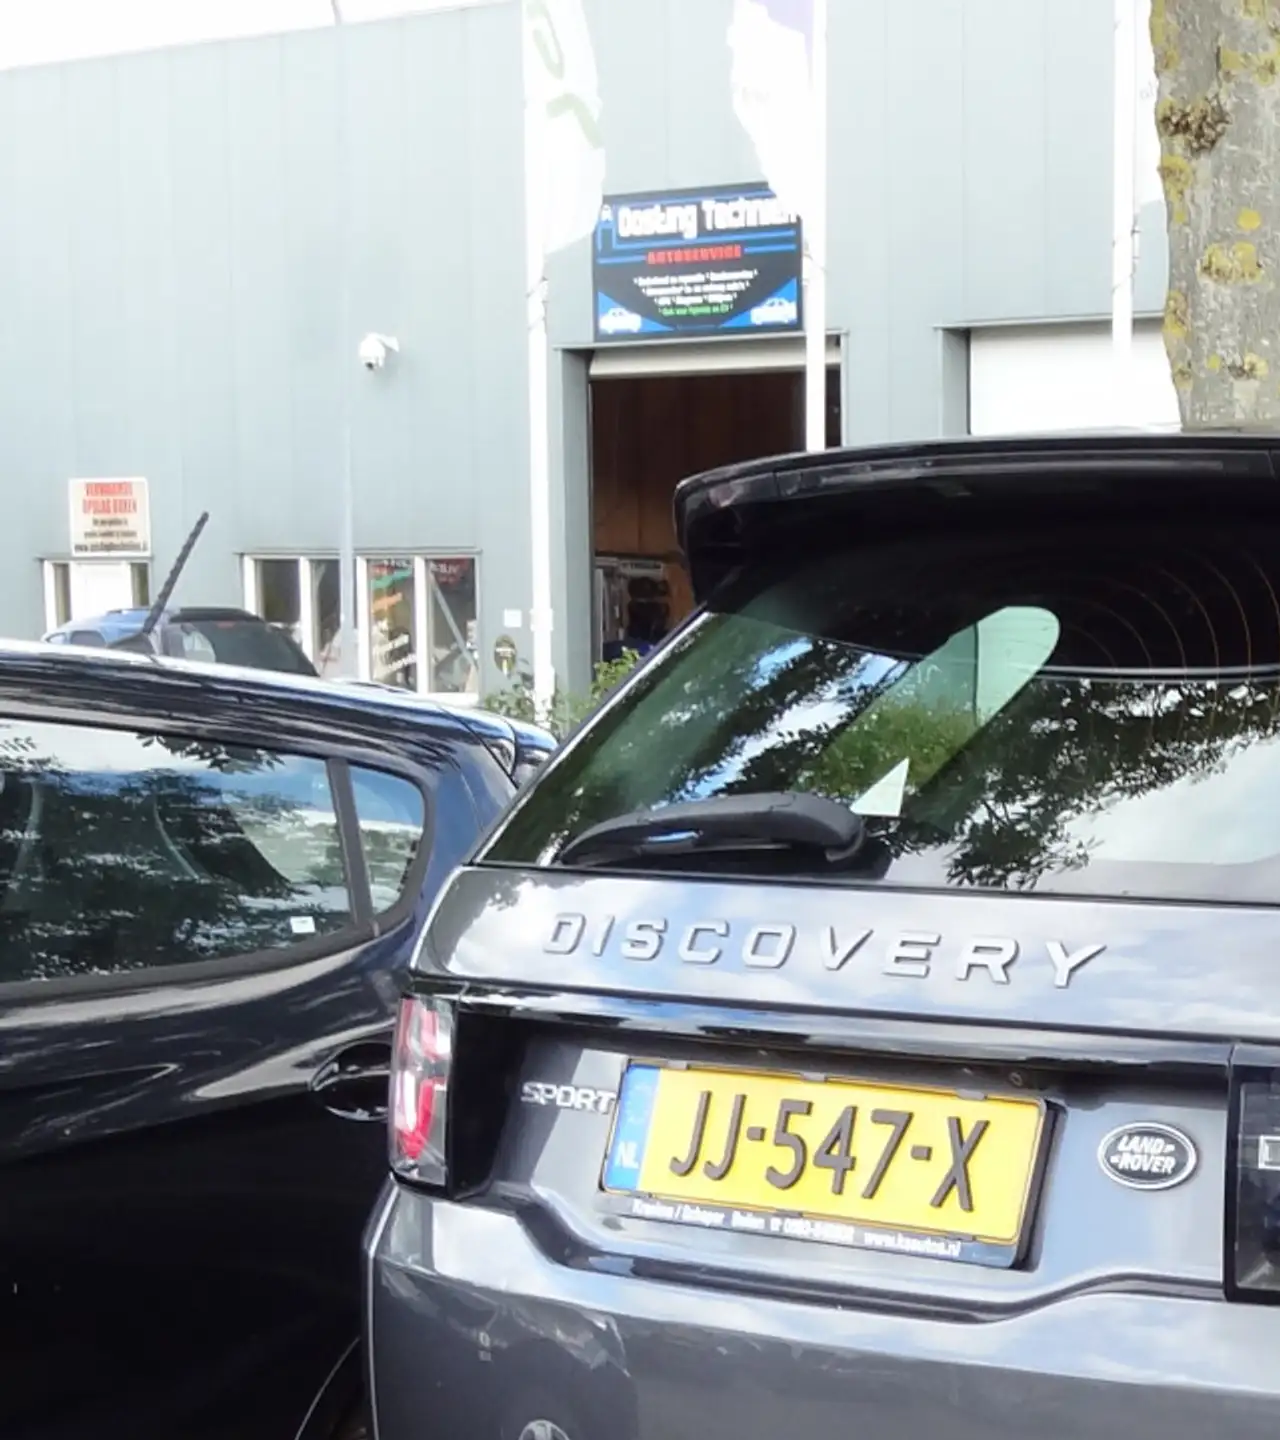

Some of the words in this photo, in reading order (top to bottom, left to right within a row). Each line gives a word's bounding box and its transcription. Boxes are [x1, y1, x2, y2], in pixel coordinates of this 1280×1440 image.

[618, 205, 698, 239] Oosting
[647, 244, 742, 265] AUTOSERVICE
[542, 912, 1107, 988] DISCOVERY
[520, 1081, 618, 1116] SPORT
[615, 1141, 640, 1169] NL
[669, 1090, 991, 1213] JJ-547-X
[1117, 1134, 1167, 1155] LAND
[1116, 1152, 1177, 1174] ROVER
